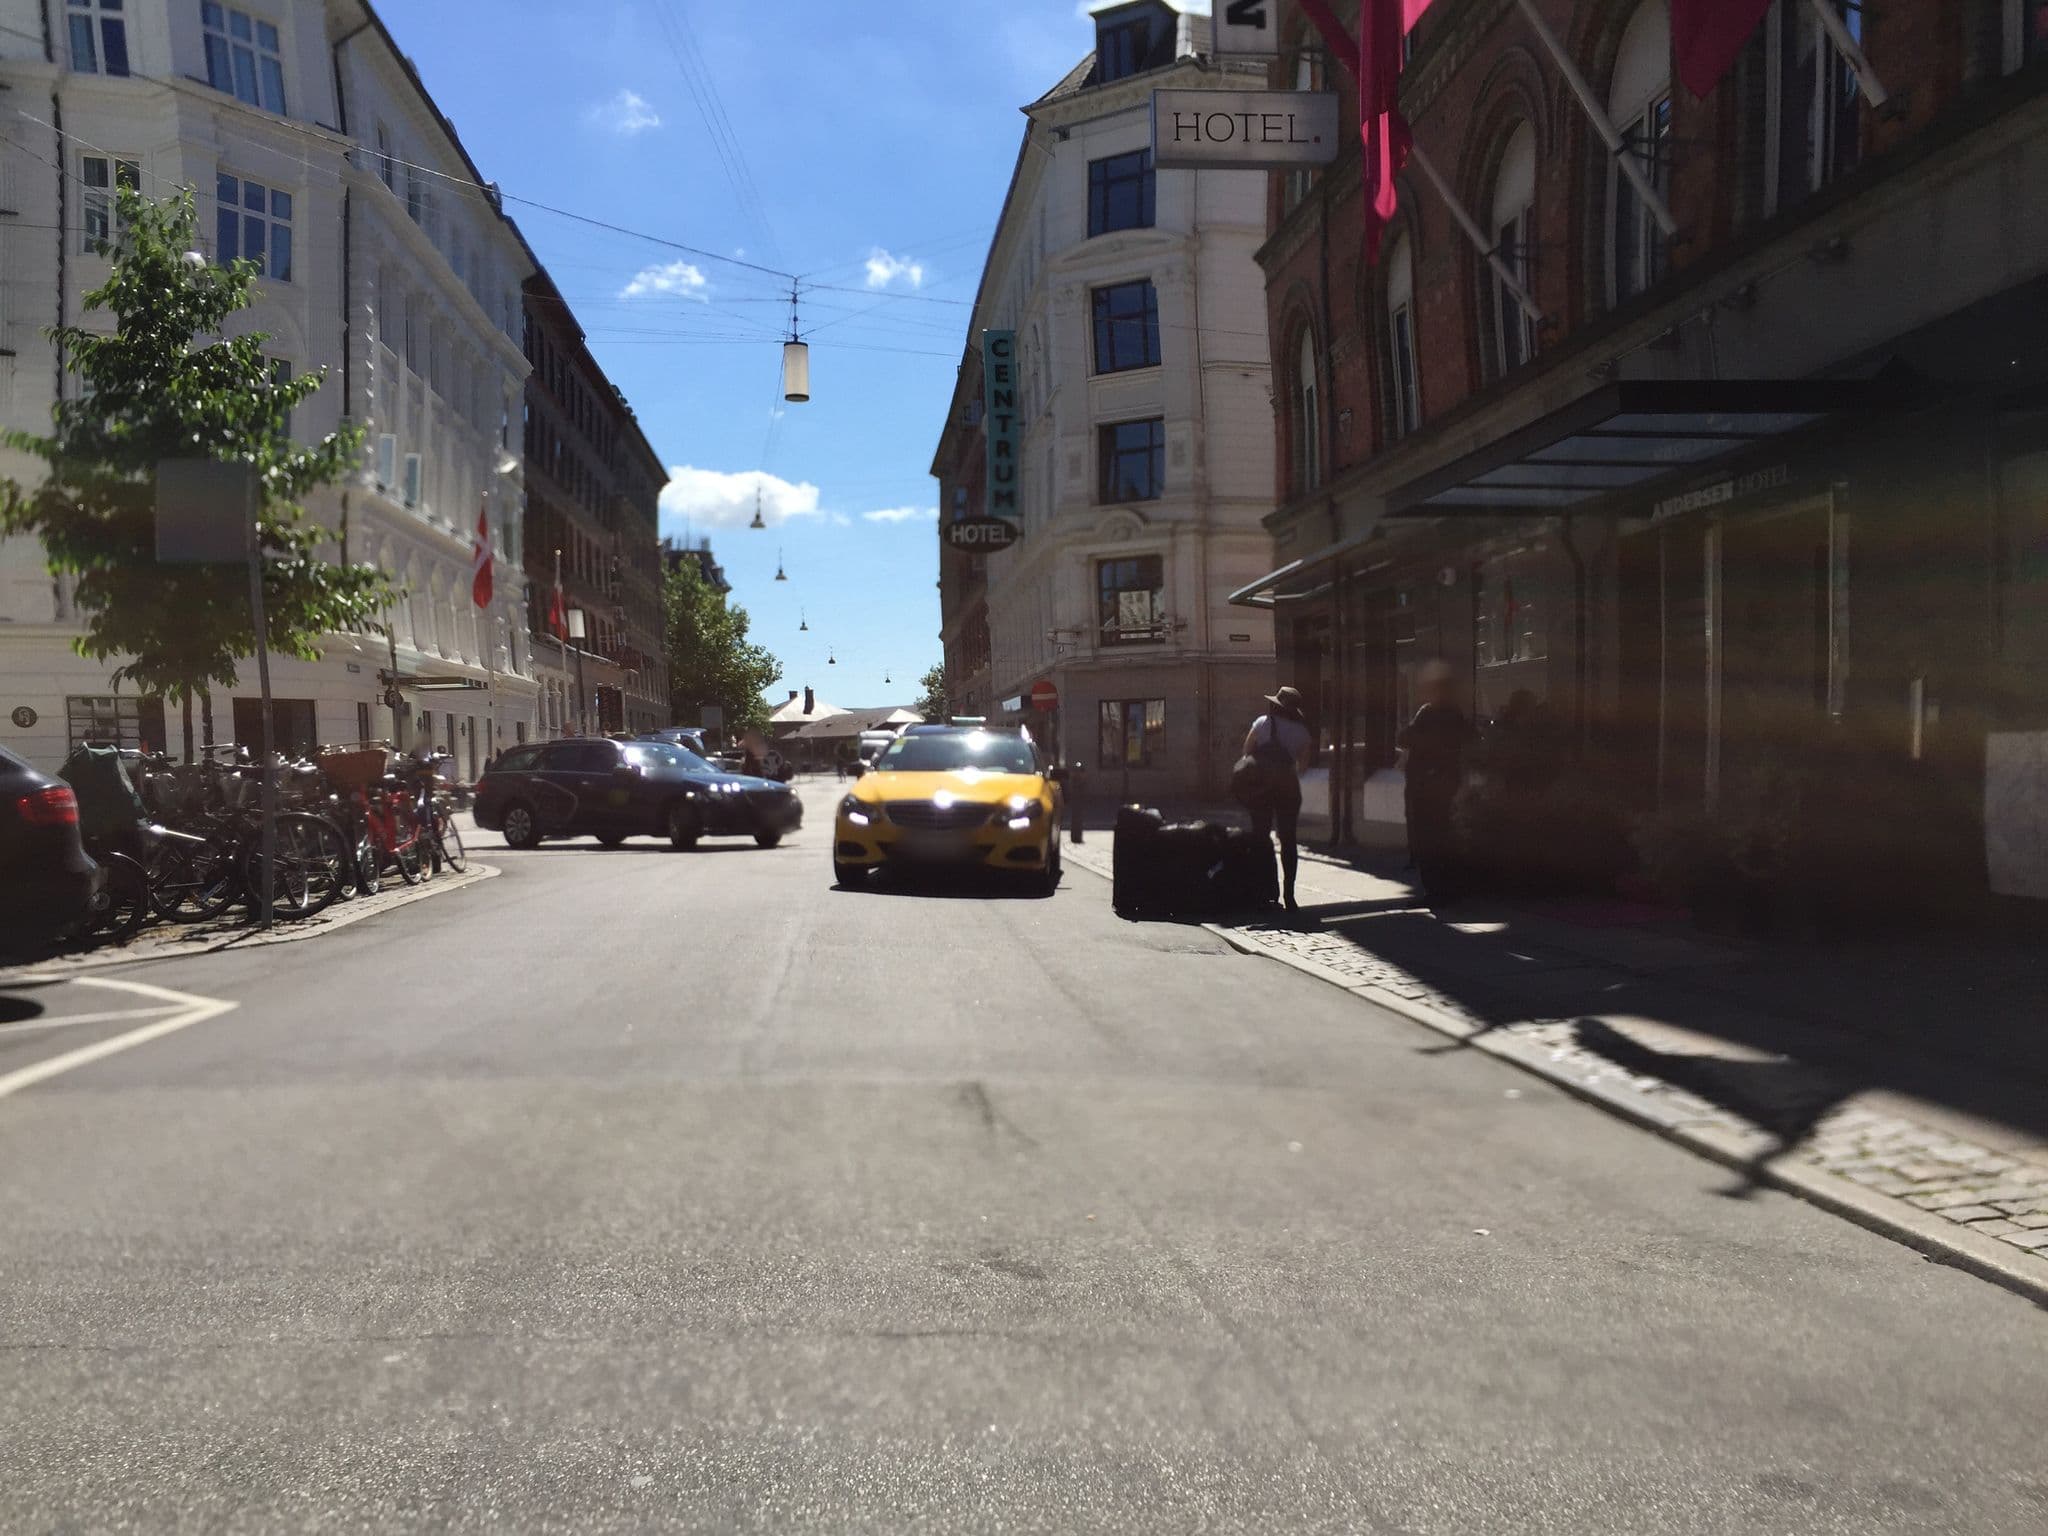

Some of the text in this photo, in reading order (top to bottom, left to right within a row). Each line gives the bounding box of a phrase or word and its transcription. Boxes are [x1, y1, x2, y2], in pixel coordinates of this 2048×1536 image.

[991, 338, 1014, 508] CENTRUM
[1650, 480, 1733, 521] ANDERSEN
[951, 524, 1010, 544] HOTEL
